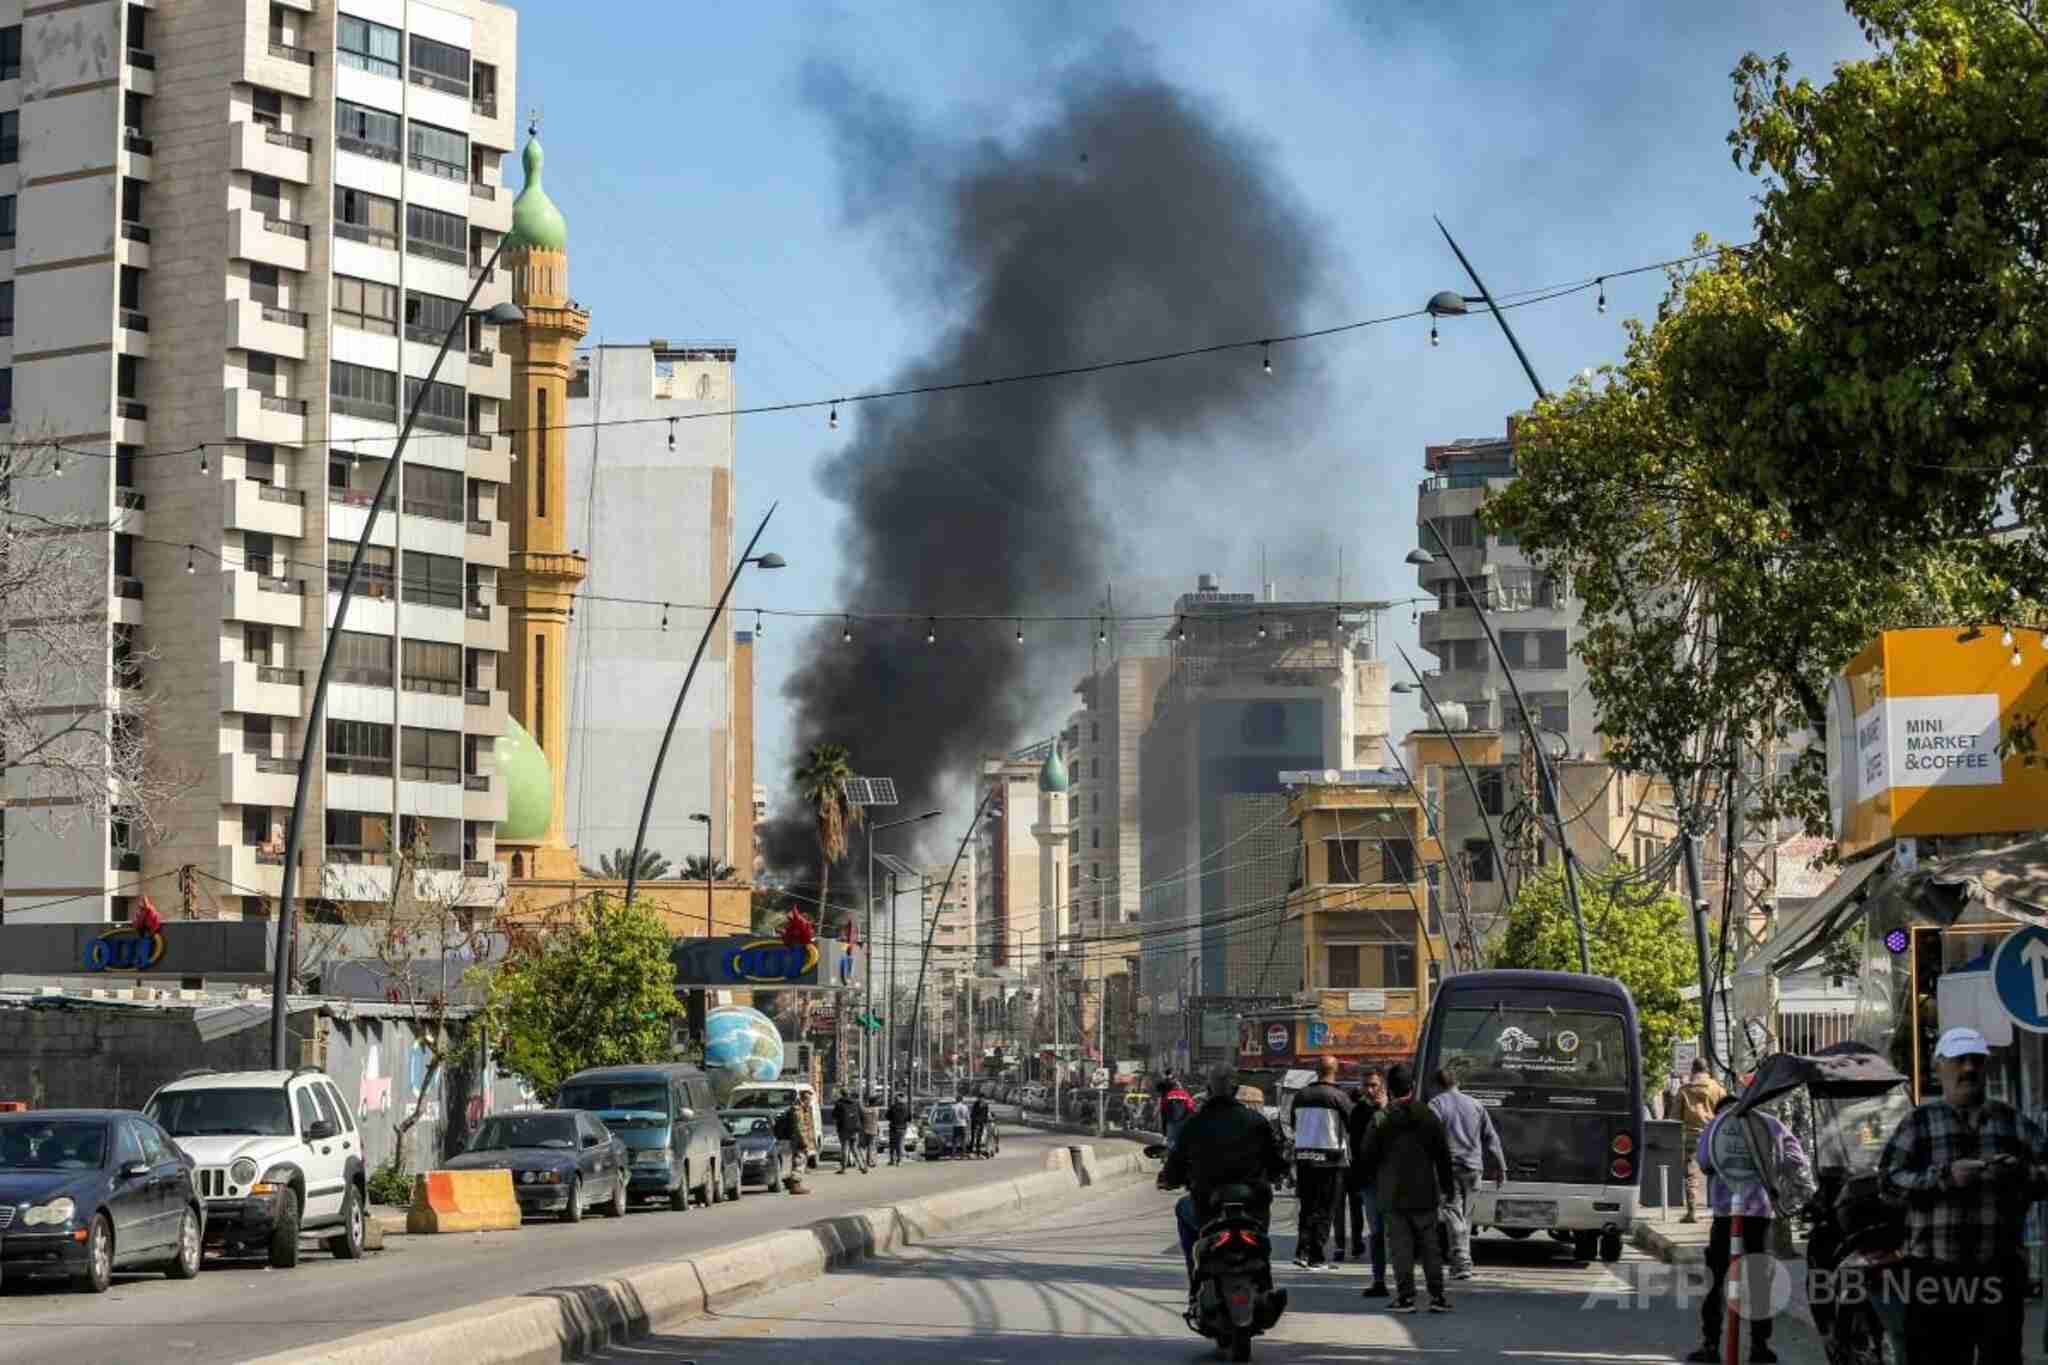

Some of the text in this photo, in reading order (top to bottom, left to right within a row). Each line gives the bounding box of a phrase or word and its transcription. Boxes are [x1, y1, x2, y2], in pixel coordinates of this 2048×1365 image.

[1906, 719, 1942, 734] MINI
[1907, 734, 1980, 750] MARKET
[1905, 753, 1988, 770] &COFFEE
